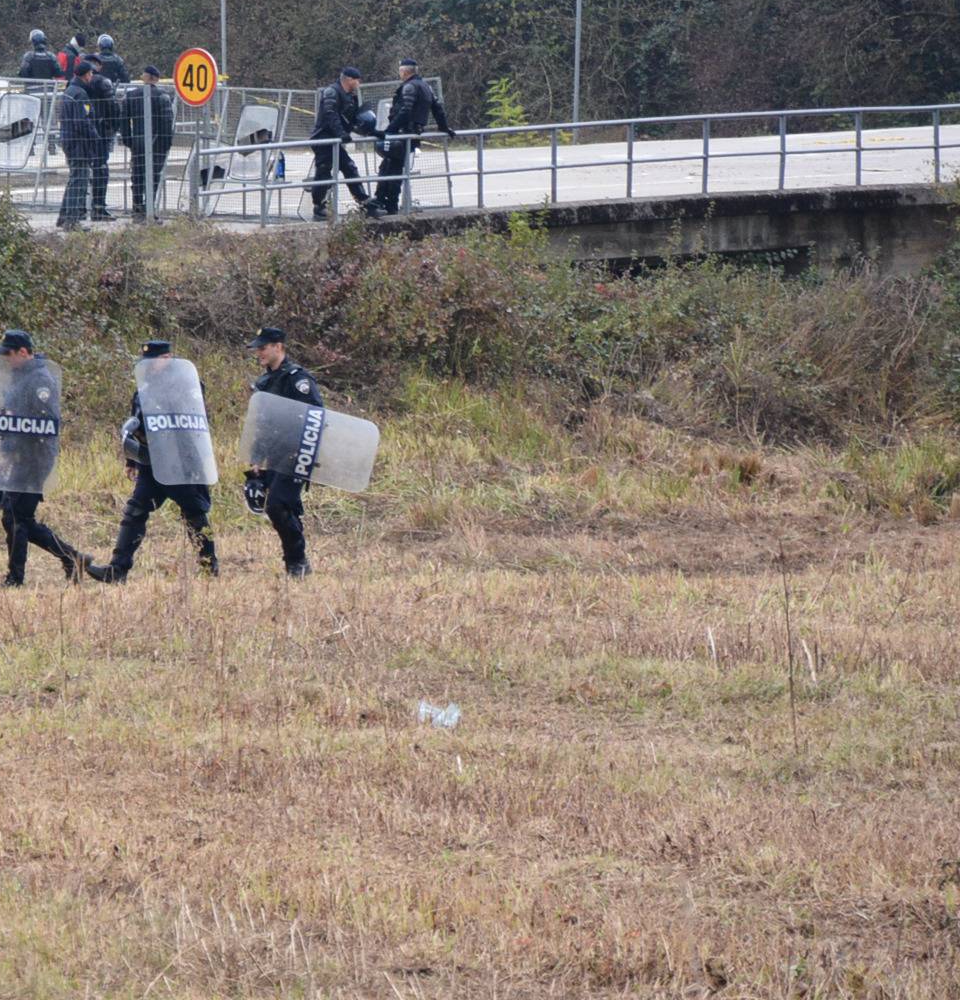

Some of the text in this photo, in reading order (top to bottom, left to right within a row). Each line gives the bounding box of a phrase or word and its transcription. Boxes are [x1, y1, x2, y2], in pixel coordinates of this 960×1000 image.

[182, 64, 208, 92] 40
[147, 414, 208, 431] POLICIJA
[295, 409, 324, 476] POLICIJA
